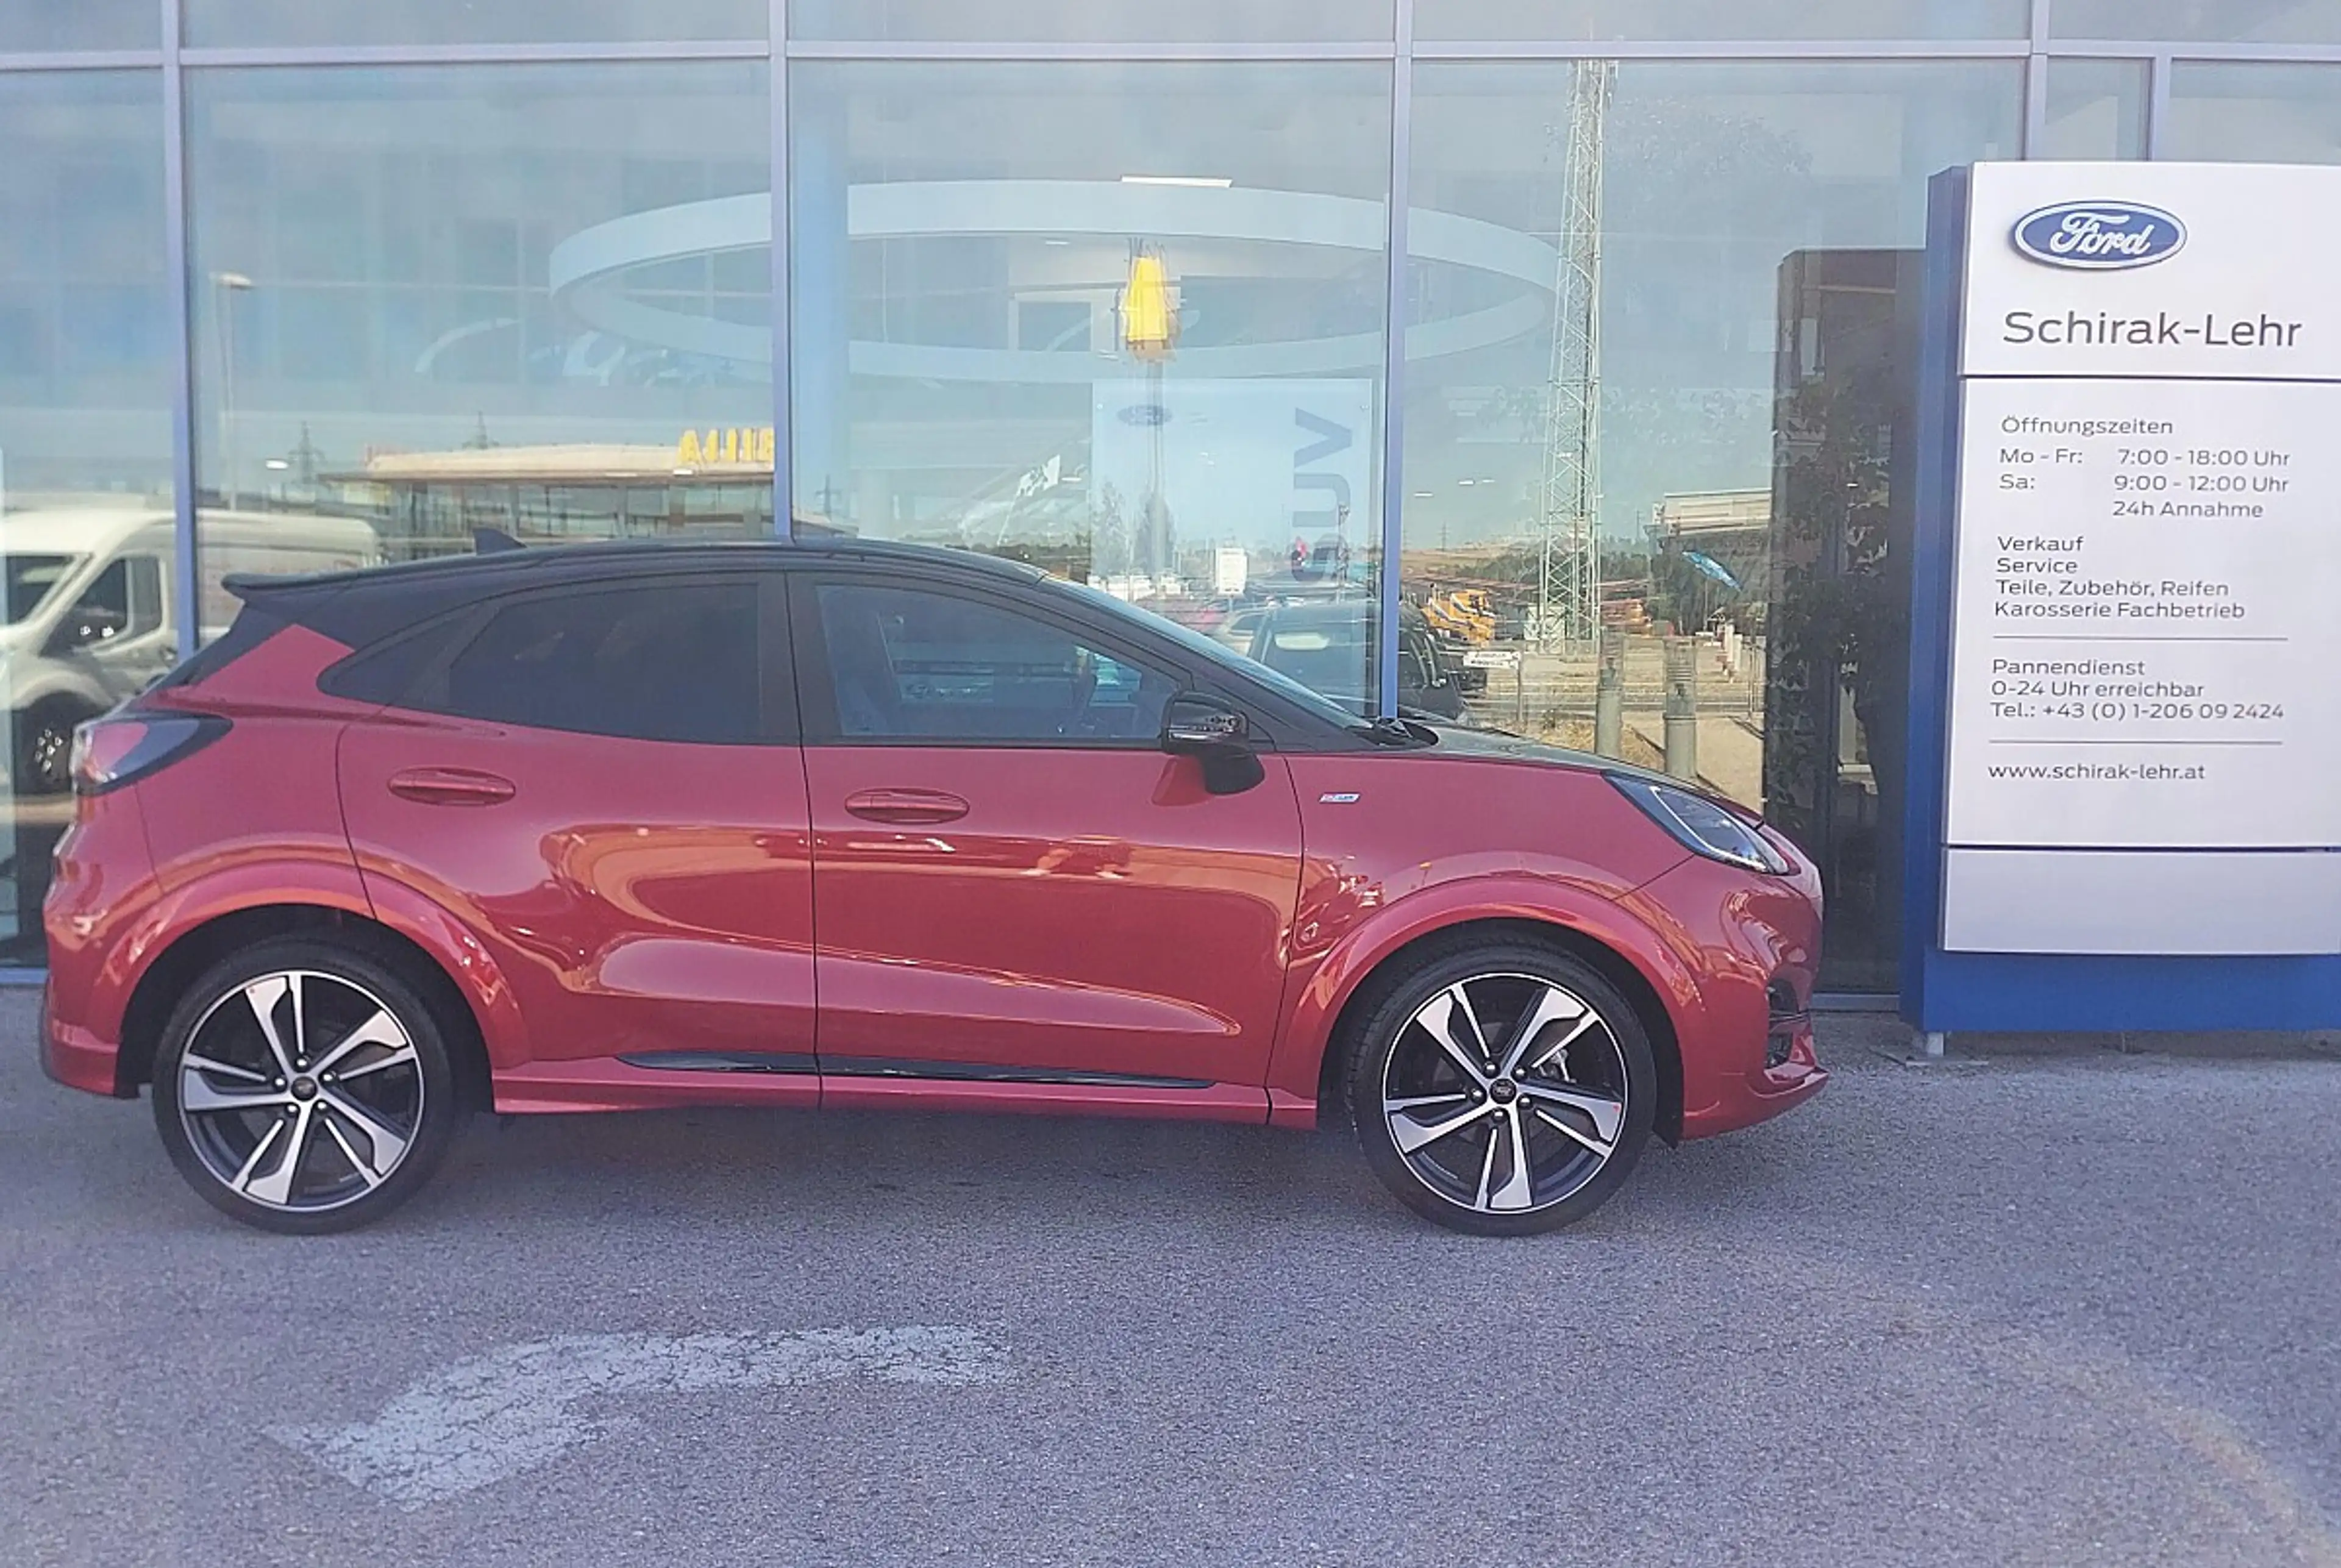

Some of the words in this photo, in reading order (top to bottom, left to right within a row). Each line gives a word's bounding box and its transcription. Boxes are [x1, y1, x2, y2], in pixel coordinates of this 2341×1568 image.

[2050, 210, 2154, 254] Ford
[2003, 310, 2303, 347] Schirak-Lehr
[2001, 415, 2173, 437] Öffnungszeiten
[2000, 449, 2034, 463] Mo
[2056, 449, 2083, 463] Fr:
[2118, 449, 2168, 465] 7:00
[2188, 450, 2248, 466] 18:00
[2254, 450, 2290, 466] Uhr
[2000, 474, 2035, 490] Sa:
[2114, 475, 2167, 490] 9:00
[2189, 476, 2246, 491] 12:00
[2253, 477, 2289, 492] Uhr
[2112, 501, 2154, 516] 24h
[2159, 501, 2263, 518] Annahme
[1998, 536, 2084, 551] Verkauf
[1996, 558, 2078, 574] Service
[1995, 579, 2053, 597] Teile,
[2059, 579, 2154, 597] Zubehör,
[2161, 580, 2228, 596] Reifen
[1995, 601, 2111, 617] Karosserie
[2117, 602, 2245, 619] Fachbetrieb
[1992, 659, 2145, 675] Pannendienst
[1992, 680, 2045, 696] 0-24
[2051, 680, 2090, 697] Uhr
[2095, 681, 2204, 697] erreichbar
[1990, 702, 2035, 718] Tel.:
[2043, 702, 2084, 718] +43
[2092, 702, 2125, 722] (0)
[2133, 704, 2193, 719] 1-206
[2199, 704, 2228, 719] 09
[2233, 704, 2284, 719] 2424
[1988, 763, 2205, 779] www.schirak-lehr.at
